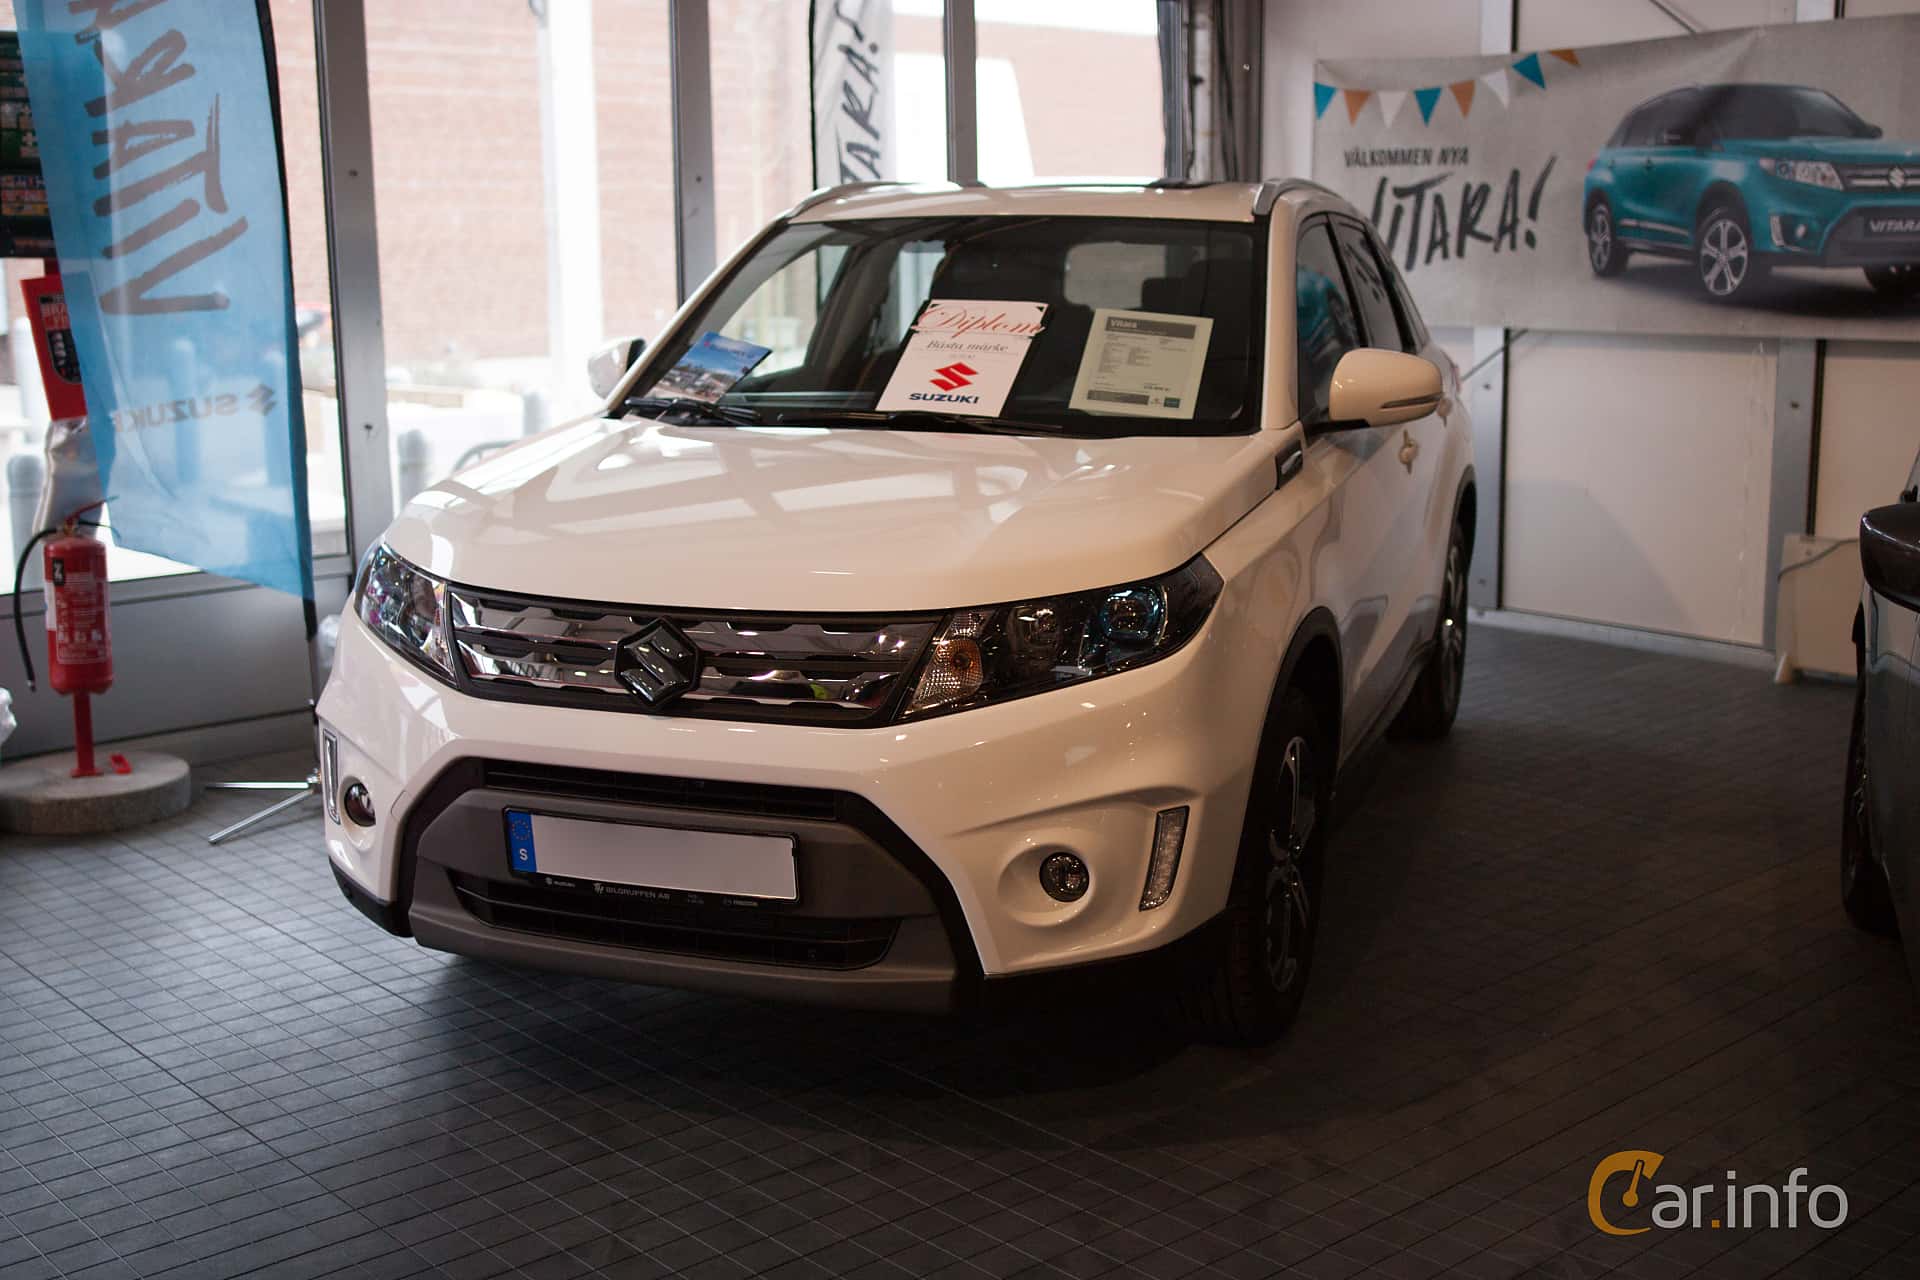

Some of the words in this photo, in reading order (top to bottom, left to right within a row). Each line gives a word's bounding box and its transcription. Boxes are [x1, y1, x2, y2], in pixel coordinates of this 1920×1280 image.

[1344, 146, 1433, 168] VÄLKOMMEN
[1437, 146, 1469, 166] NYA
[917, 305, 1047, 339] Diplom
[909, 392, 980, 404] SUZUKI
[519, 848, 529, 861] S
